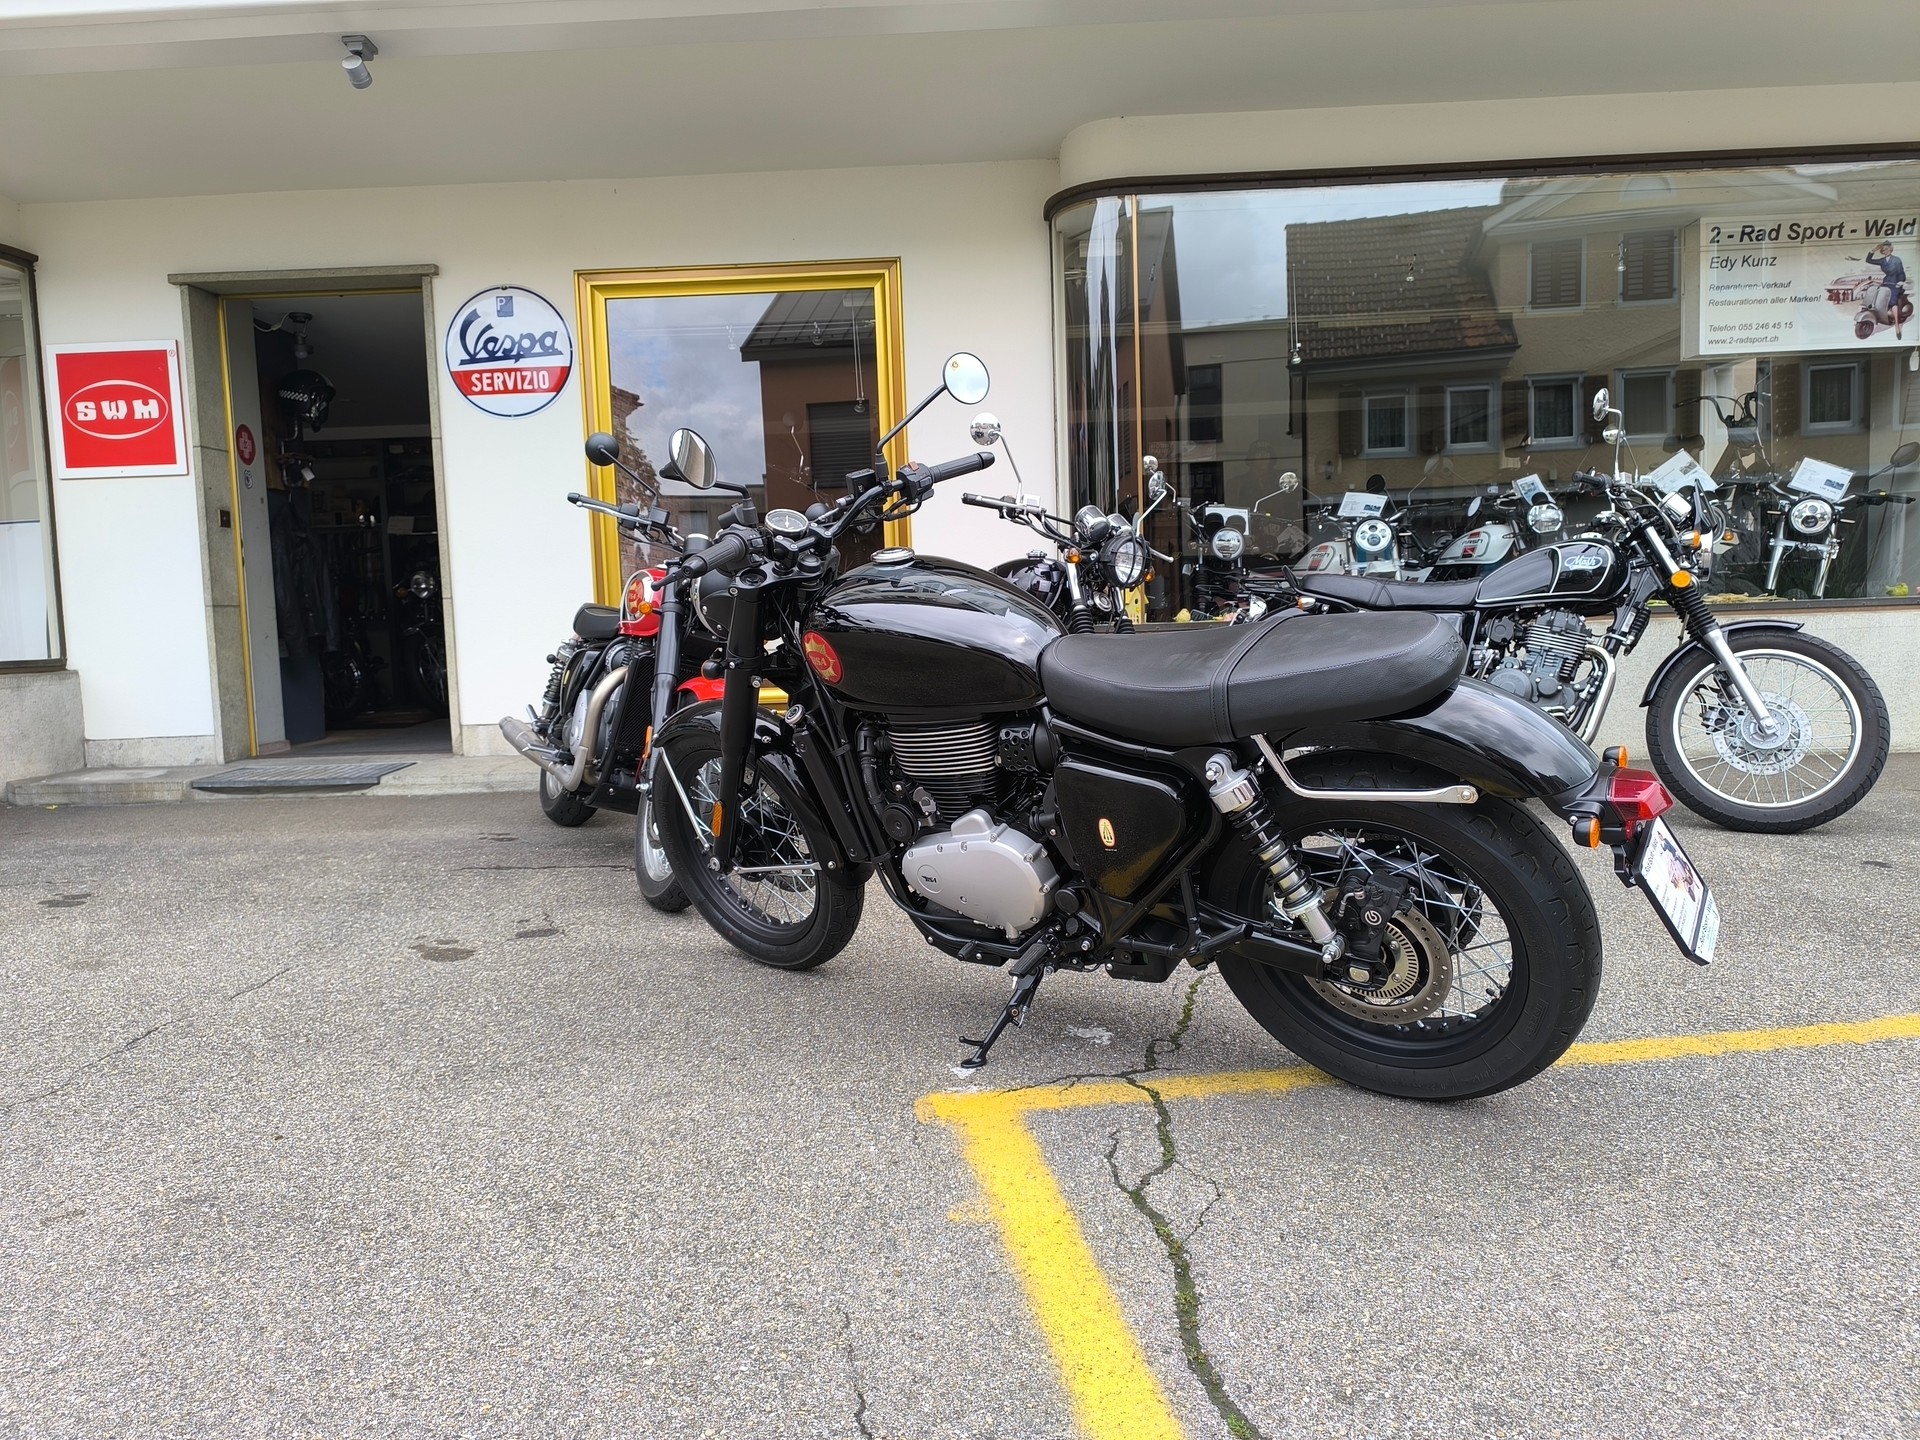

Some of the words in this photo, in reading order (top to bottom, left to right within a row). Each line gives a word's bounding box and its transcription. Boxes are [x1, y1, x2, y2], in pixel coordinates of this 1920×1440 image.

[1709, 226, 1721, 244] 2
[1739, 223, 1782, 243] Rad
[1787, 221, 1845, 245] Sport
[1865, 217, 1917, 237] Wald
[1709, 256, 1737, 272] Edy
[1741, 254, 1778, 268] Kunz
[1709, 280, 1792, 293] Reparaturen-Verkauf
[1708, 297, 1768, 307] Restaurationen
[1770, 296, 1788, 304] aller
[1789, 294, 1822, 303] Marken!
[459, 308, 558, 364] Vespa
[1708, 323, 1736, 333] Telefon
[1738, 323, 1753, 331] 055
[1755, 322, 1770, 330] 246
[1771, 321, 1782, 329] 45
[1784, 321, 1793, 329] 15
[1708, 335, 1779, 345] www.2-radsport.ch
[471, 370, 550, 392] SERVIZIO
[75, 399, 160, 421] SWM
